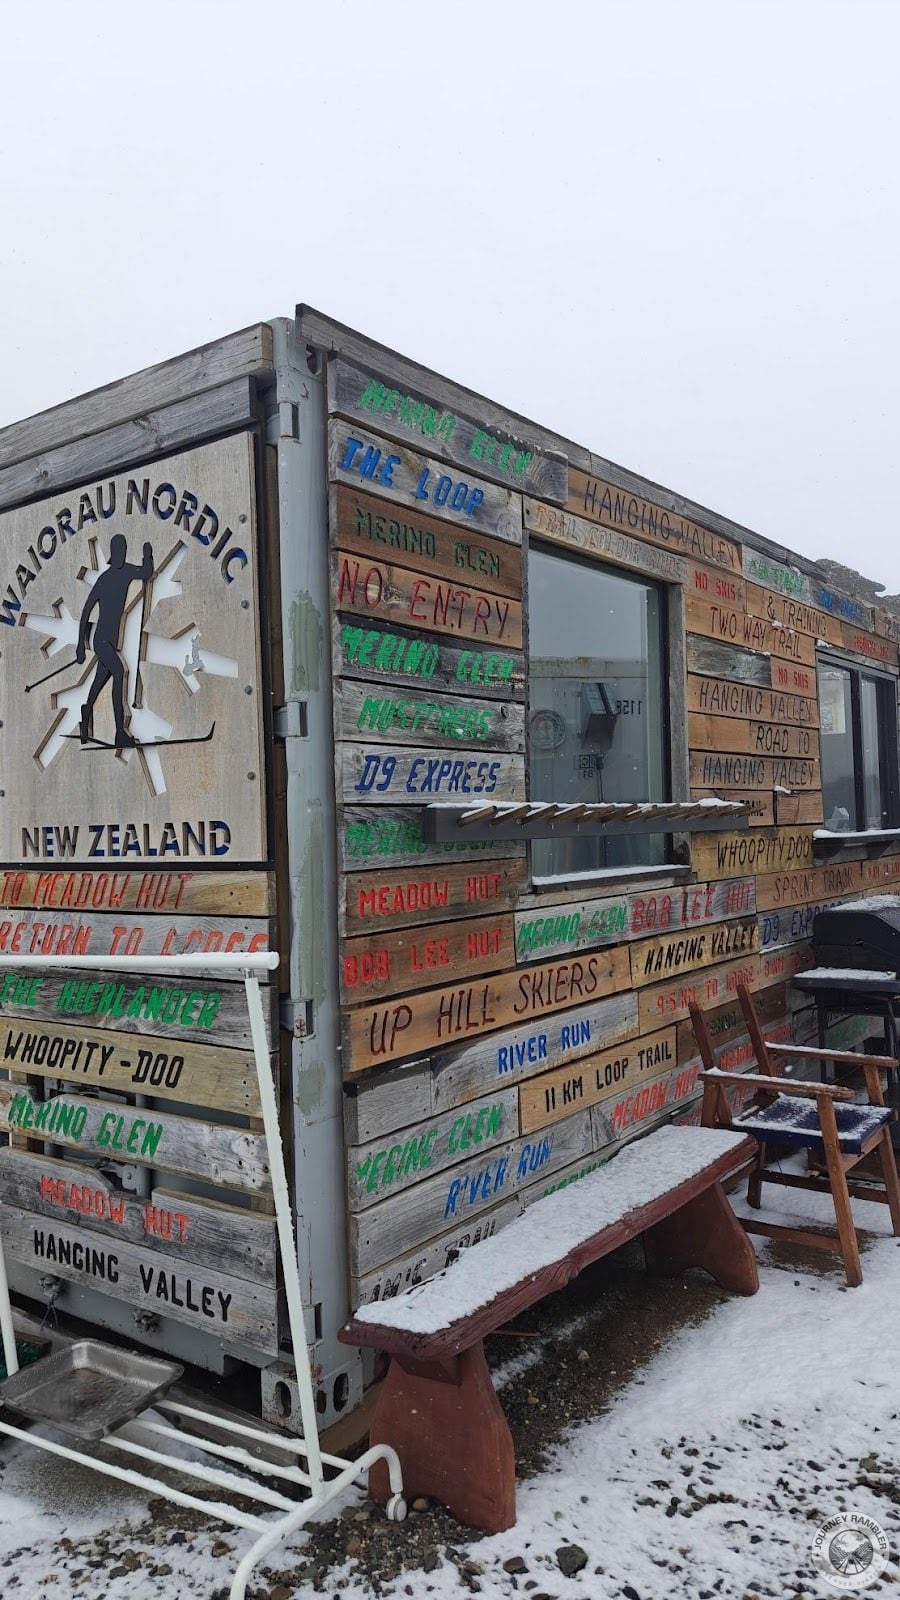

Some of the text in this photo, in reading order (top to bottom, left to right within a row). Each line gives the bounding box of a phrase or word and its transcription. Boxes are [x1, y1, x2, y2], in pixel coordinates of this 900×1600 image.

[342, 437, 485, 517] THE LOOP
[355, 509, 501, 579] MERINO GLEN
[536, 505, 580, 541] TRAIL
[583, 480, 737, 570] HANGING VALLEY
[0, 478, 249, 627] WAIORAU NORDIC
[337, 558, 511, 639] NO ENTRY
[694, 570, 737, 602] NO SKIS
[710, 606, 803, 660] TWO WAY TRAIL
[766, 595, 777, 621] &
[781, 599, 828, 638] TRAINING
[341, 625, 515, 687] MERINO GLEN
[778, 666, 809, 690] NO SKIS
[700, 682, 813, 723] HANGING VALLEY
[755, 724, 810, 755] ROAD TO
[354, 754, 501, 794] D9 EXPRESS
[702, 756, 814, 786] HANGING VALLEY
[21, 820, 232, 858] NEW ZEALAND
[717, 834, 811, 873] WHOOPITY DOO
[1, 872, 193, 911] TO MEADOW HUT
[357, 873, 502, 920] MEADOW HUT
[630, 882, 754, 934] BOB LEE HUT
[773, 872, 818, 903] SPRINT
[821, 868, 855, 895] TRACK
[0, 919, 94, 957] RETURN
[109, 925, 145, 957] TO
[516, 911, 582, 952] MERINO
[644, 933, 706, 976] HANGING
[711, 924, 757, 958] VALLEY
[761, 914, 781, 947] D9
[343, 928, 502, 987] BOB LEE HUT
[0, 973, 223, 1029] THE HIGHLANDER
[369, 957, 600, 1056] UP HILL SKIERS
[704, 978, 719, 1000] TO
[498, 1019, 592, 1075] RIVER RUN
[562, 1075, 584, 1104] KM
[595, 1057, 630, 1091] LOOP
[637, 1040, 673, 1072] TRAIL
[7, 1093, 164, 1158] MERINO GLEN
[610, 1079, 670, 1135] MEADOW
[673, 1064, 700, 1102] HUT
[447, 1103, 505, 1156] GLEN
[443, 1154, 510, 1221] RIVER
[516, 1132, 556, 1181] RUN
[39, 1174, 191, 1244] MEADOW HUT
[33, 1229, 233, 1323] HANGING VALLEY
